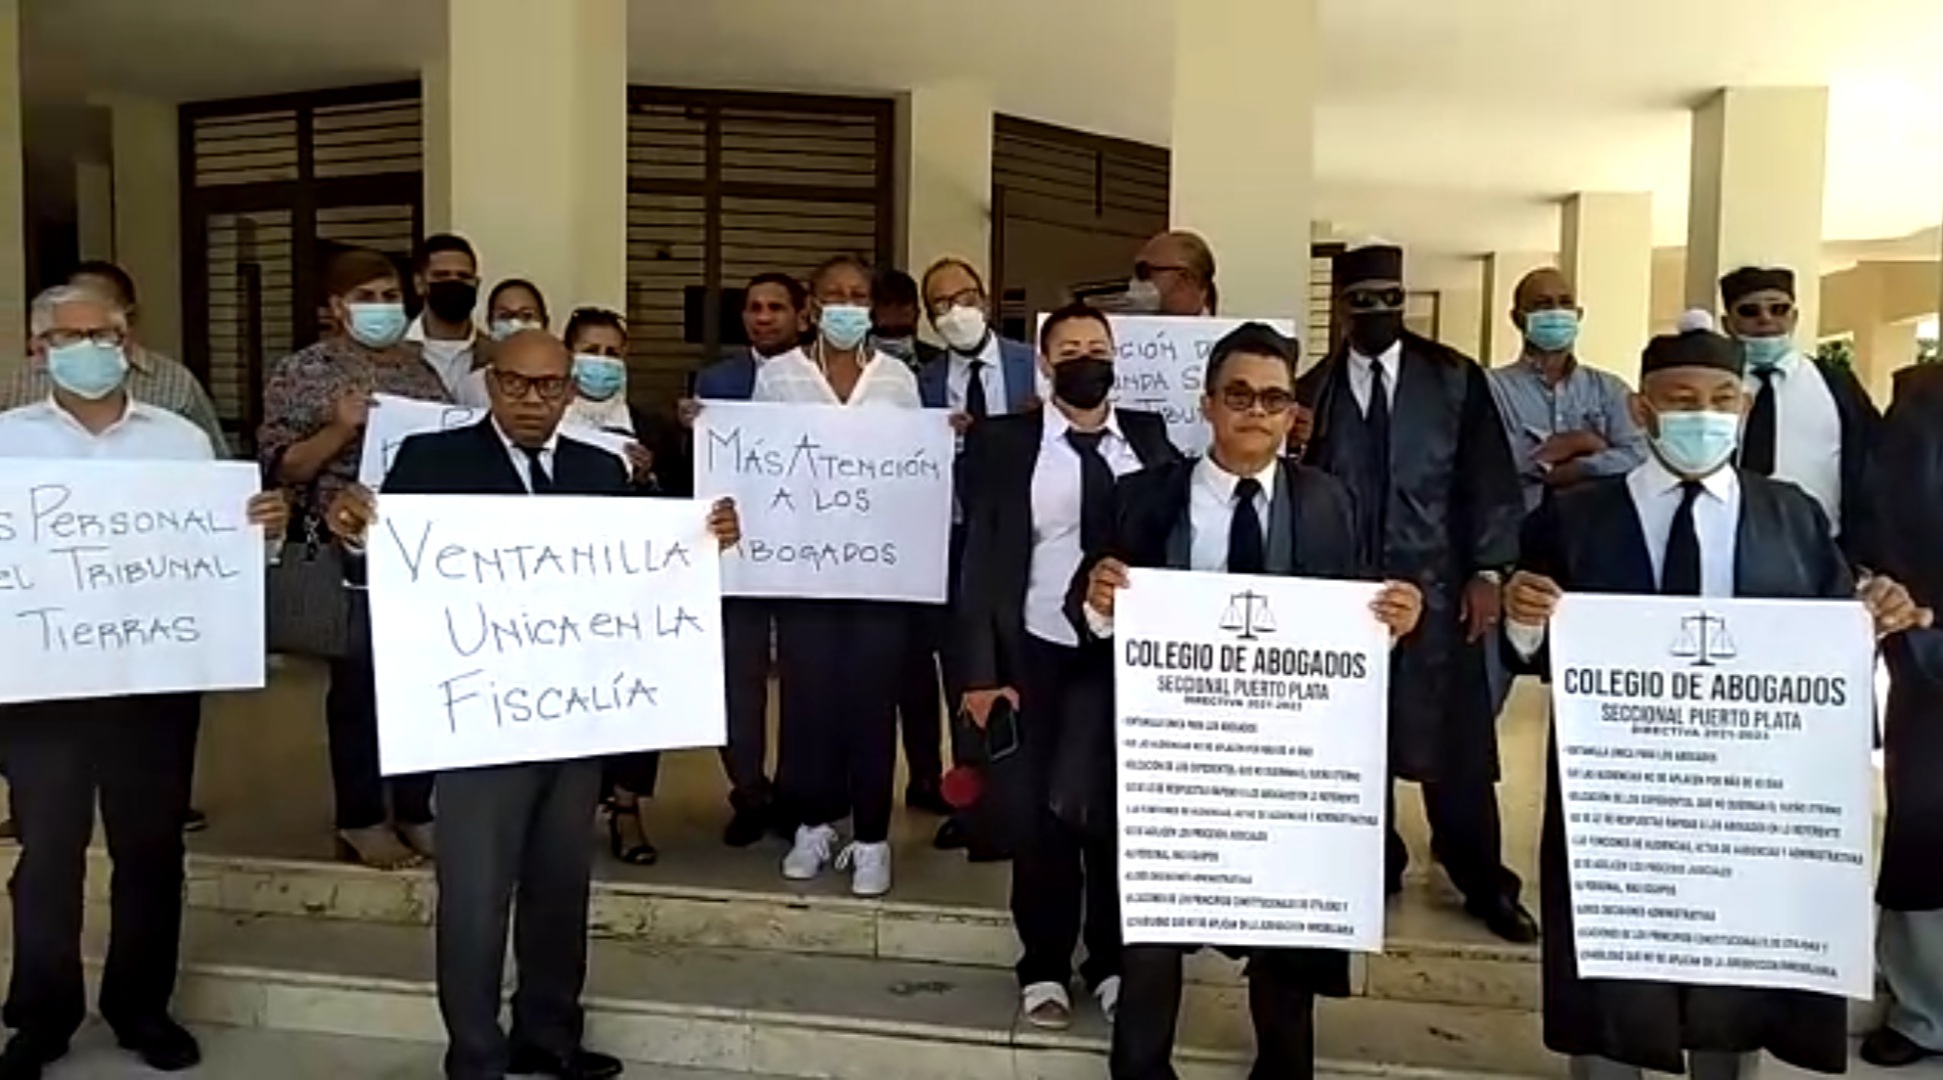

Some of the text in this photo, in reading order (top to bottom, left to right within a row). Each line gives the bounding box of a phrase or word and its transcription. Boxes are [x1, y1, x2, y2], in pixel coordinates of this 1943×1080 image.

[771, 487, 870, 512] A LOS
[49, 545, 240, 591] TRIBUNAL
[1125, 638, 1367, 679] COLEGIO DE ABOGADOS
[1157, 675, 1329, 701] SECCIONAL PUERTO PLATA
[1563, 668, 1847, 705] COLEGIO DE ABOGADOS
[1601, 703, 1802, 731] SECCIONAL PUERTO PLATA
